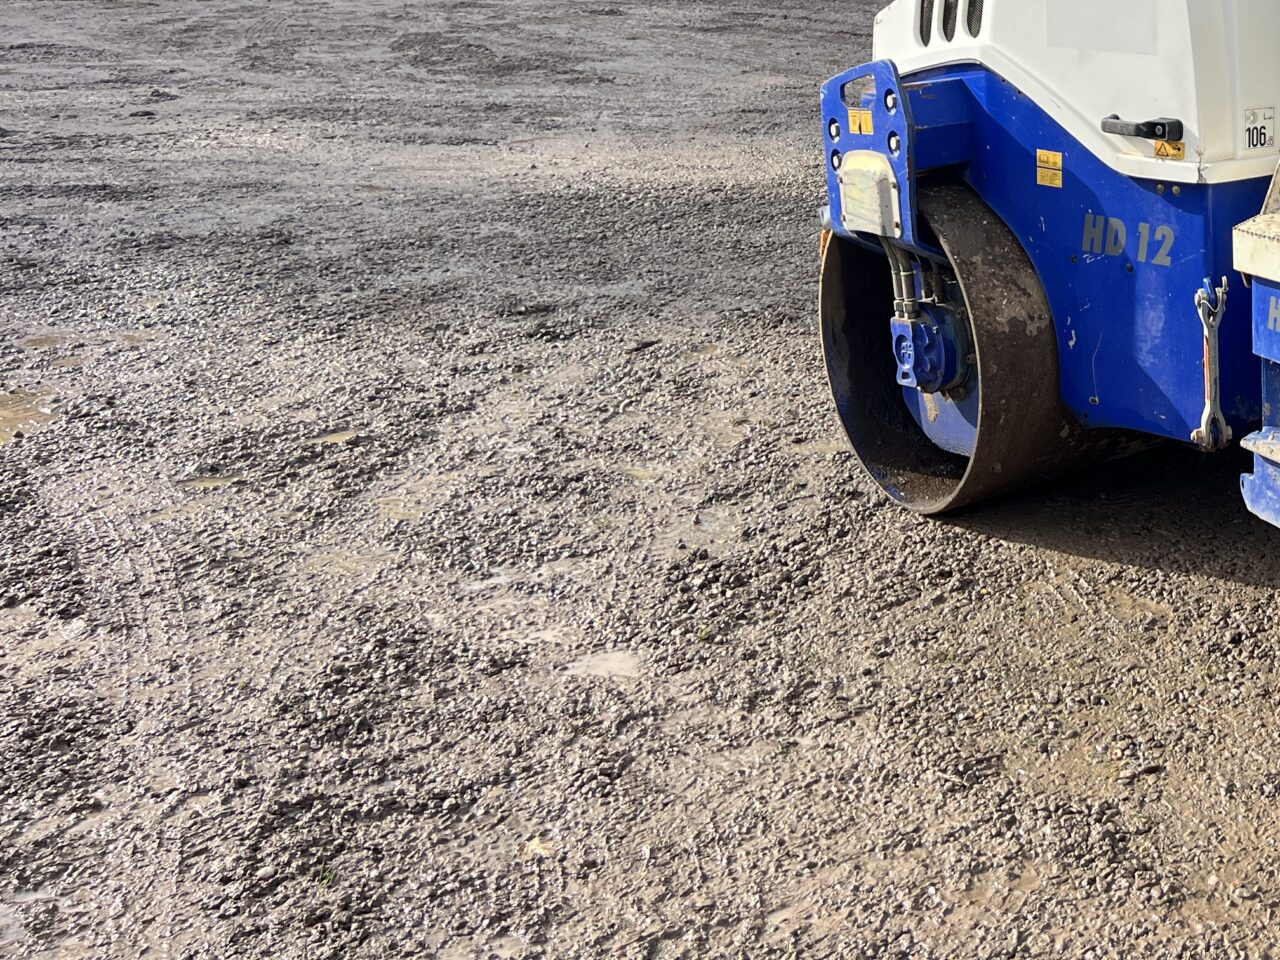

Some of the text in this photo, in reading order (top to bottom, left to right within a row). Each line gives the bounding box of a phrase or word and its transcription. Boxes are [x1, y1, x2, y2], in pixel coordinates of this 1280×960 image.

[1245, 126, 1266, 147] 106
[1082, 214, 1174, 266] HD 12
